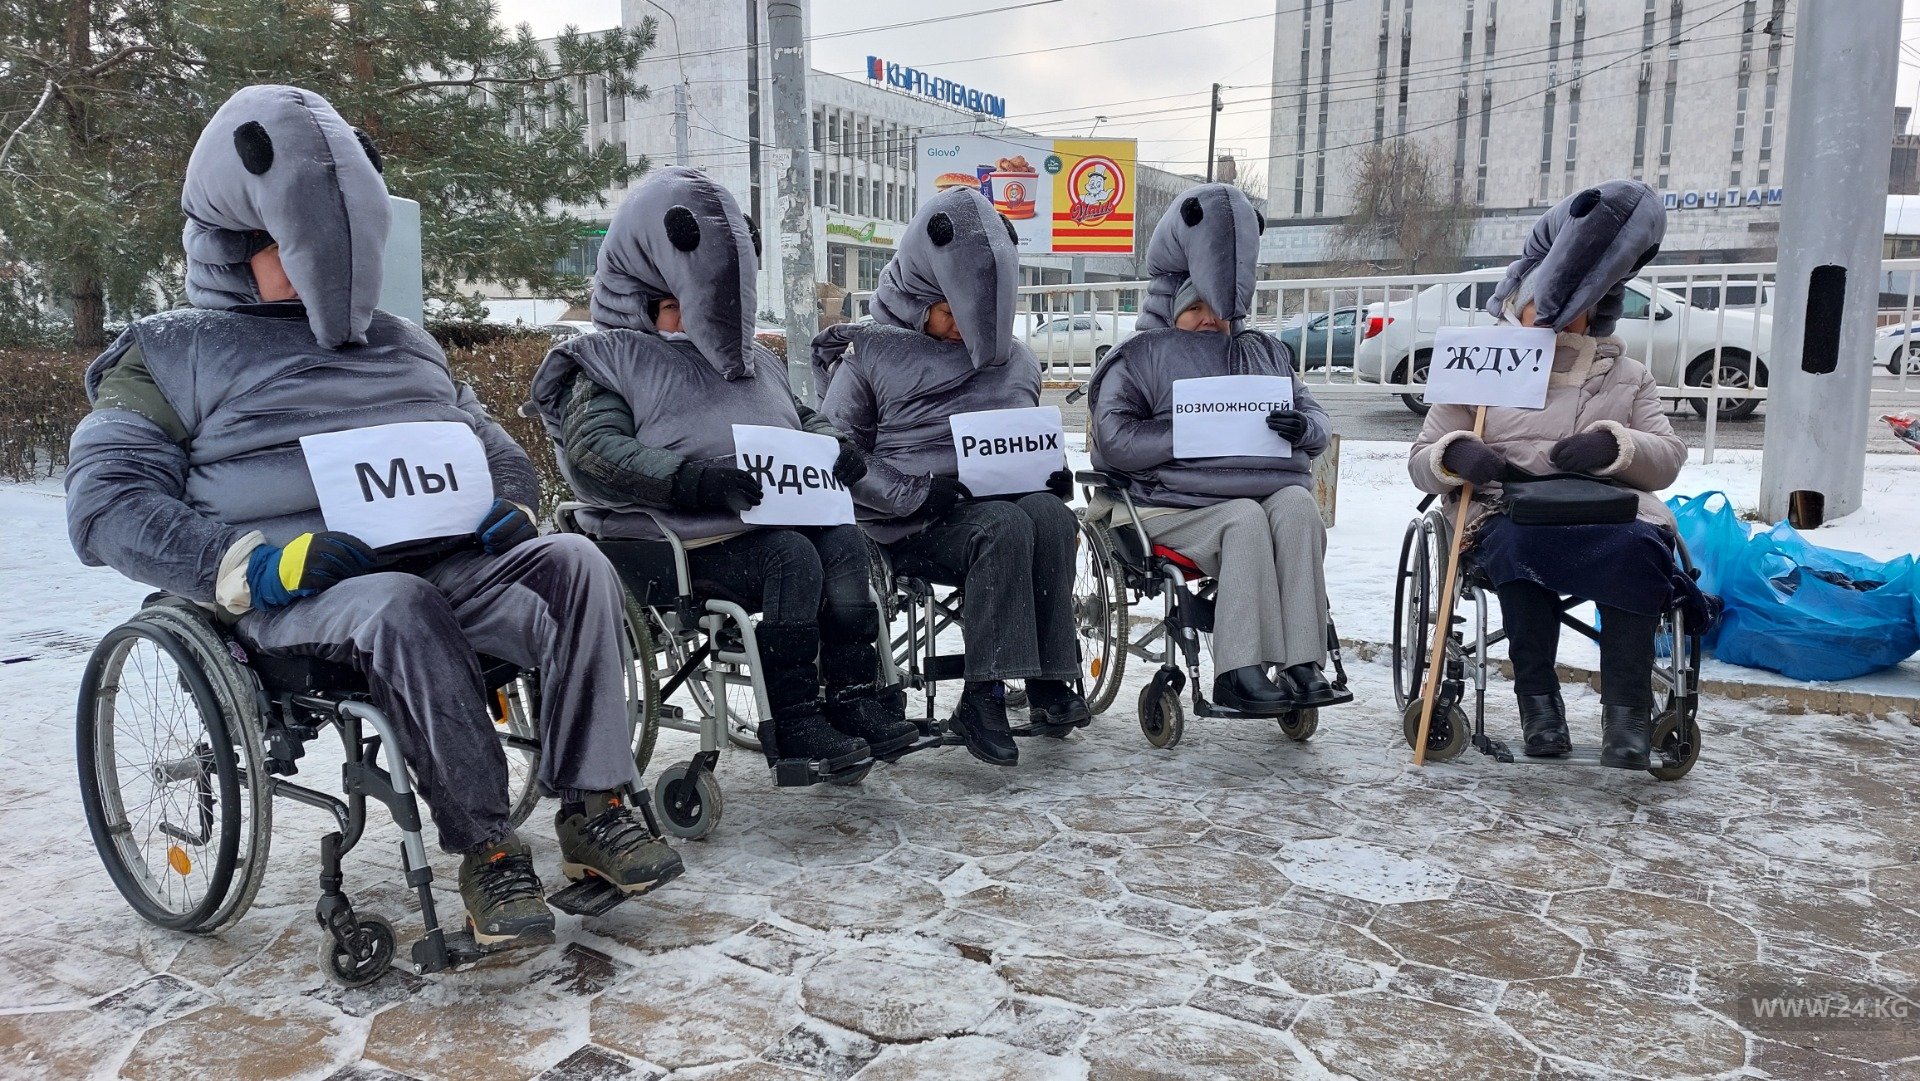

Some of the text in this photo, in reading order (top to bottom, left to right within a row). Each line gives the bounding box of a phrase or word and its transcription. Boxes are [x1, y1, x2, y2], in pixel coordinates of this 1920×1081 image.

[927, 146, 960, 157] Glovo
[1444, 346, 1543, 376] ЖДУ!
[1176, 399, 1290, 415] ВОЗМОЖНОСТЕЙ
[962, 432, 1059, 458] Равных
[354, 457, 459, 503] Мы
[742, 453, 846, 495] Ждем
